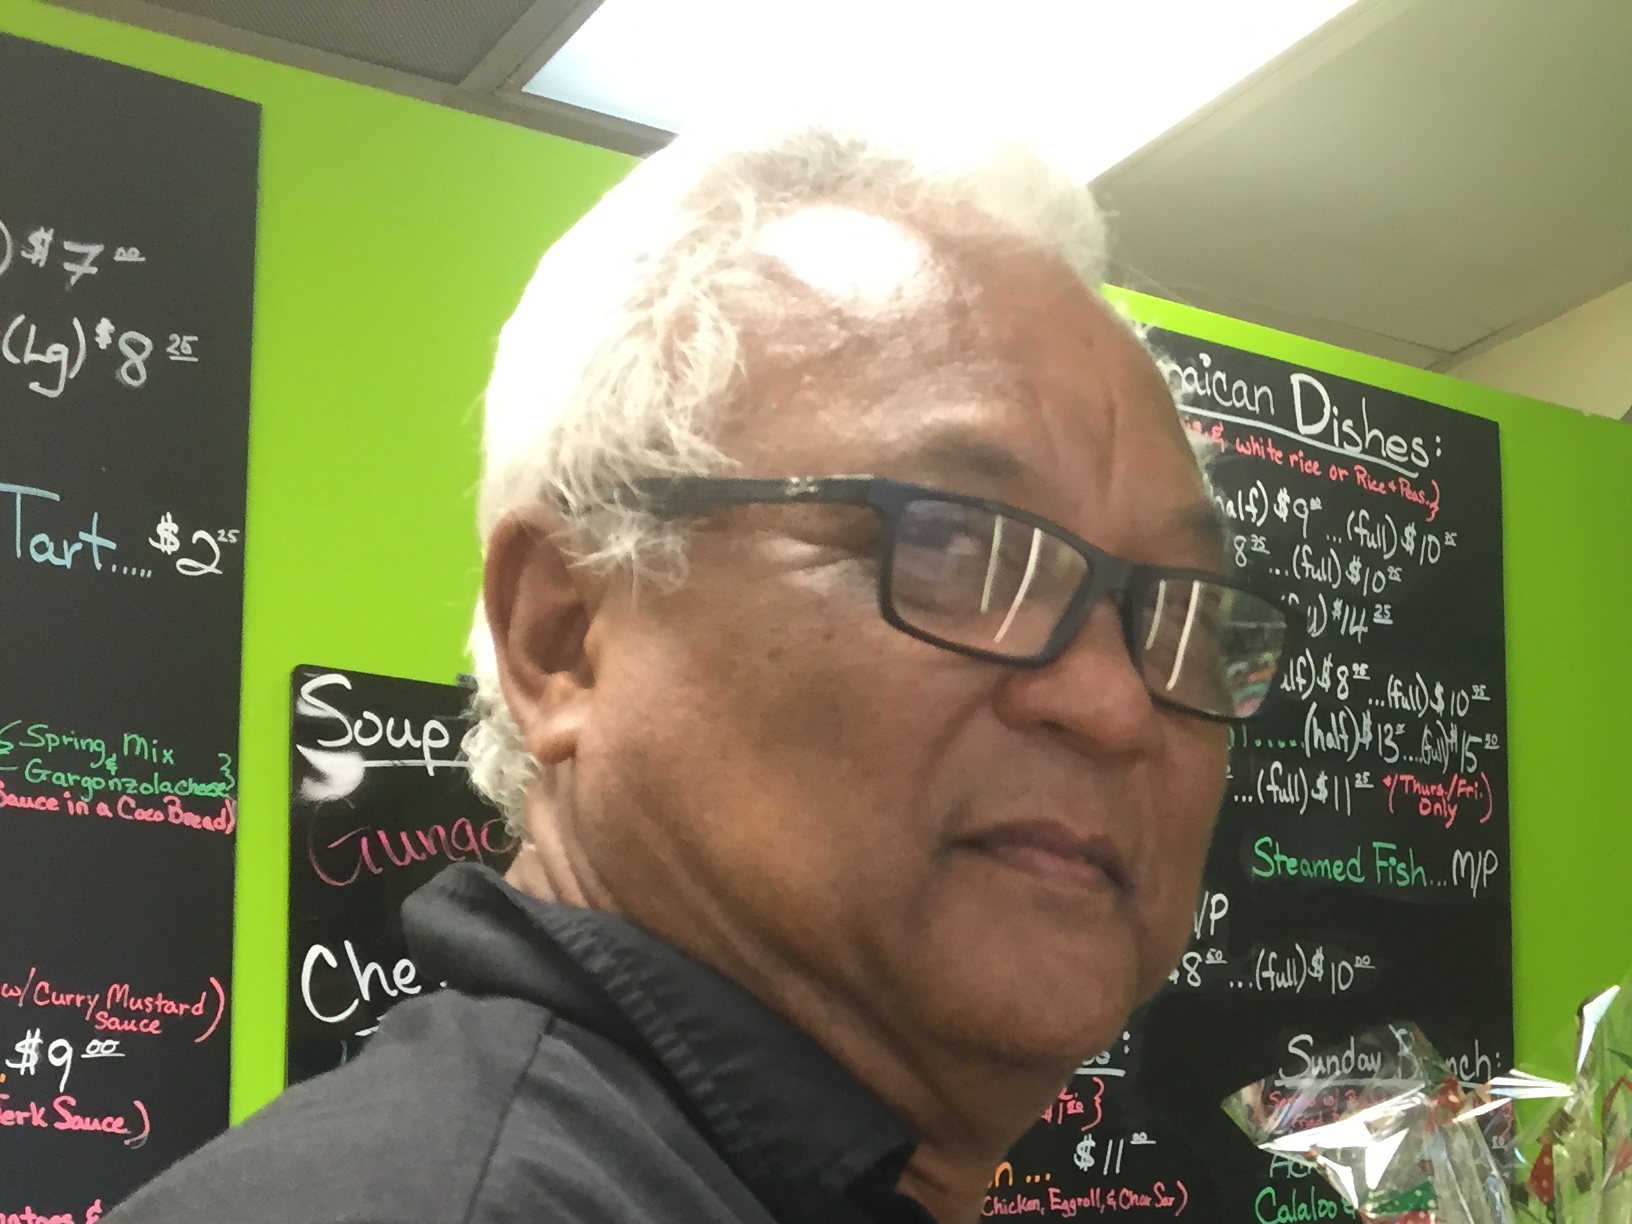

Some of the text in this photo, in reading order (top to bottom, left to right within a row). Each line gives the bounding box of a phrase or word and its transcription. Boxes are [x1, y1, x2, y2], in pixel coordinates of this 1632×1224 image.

[1291, 372, 1442, 468] Dishes:
[1235, 435, 1284, 466] white
[1288, 448, 1323, 477] rice
[1328, 463, 1350, 482] or
[19, 723, 176, 769] Spring Mix
[63, 790, 90, 816] in
[96, 801, 114, 818] a
[1418, 797, 1458, 829] Only
[1252, 836, 1366, 884] Steamed
[1452, 848, 1500, 899] M/P
[33, 980, 100, 1021] Curry
[301, 939, 423, 1024] Che
[94, 1009, 162, 1034] Sauce
[1276, 1033, 1382, 1082] Sunday
[0, 1094, 48, 1129] erk
